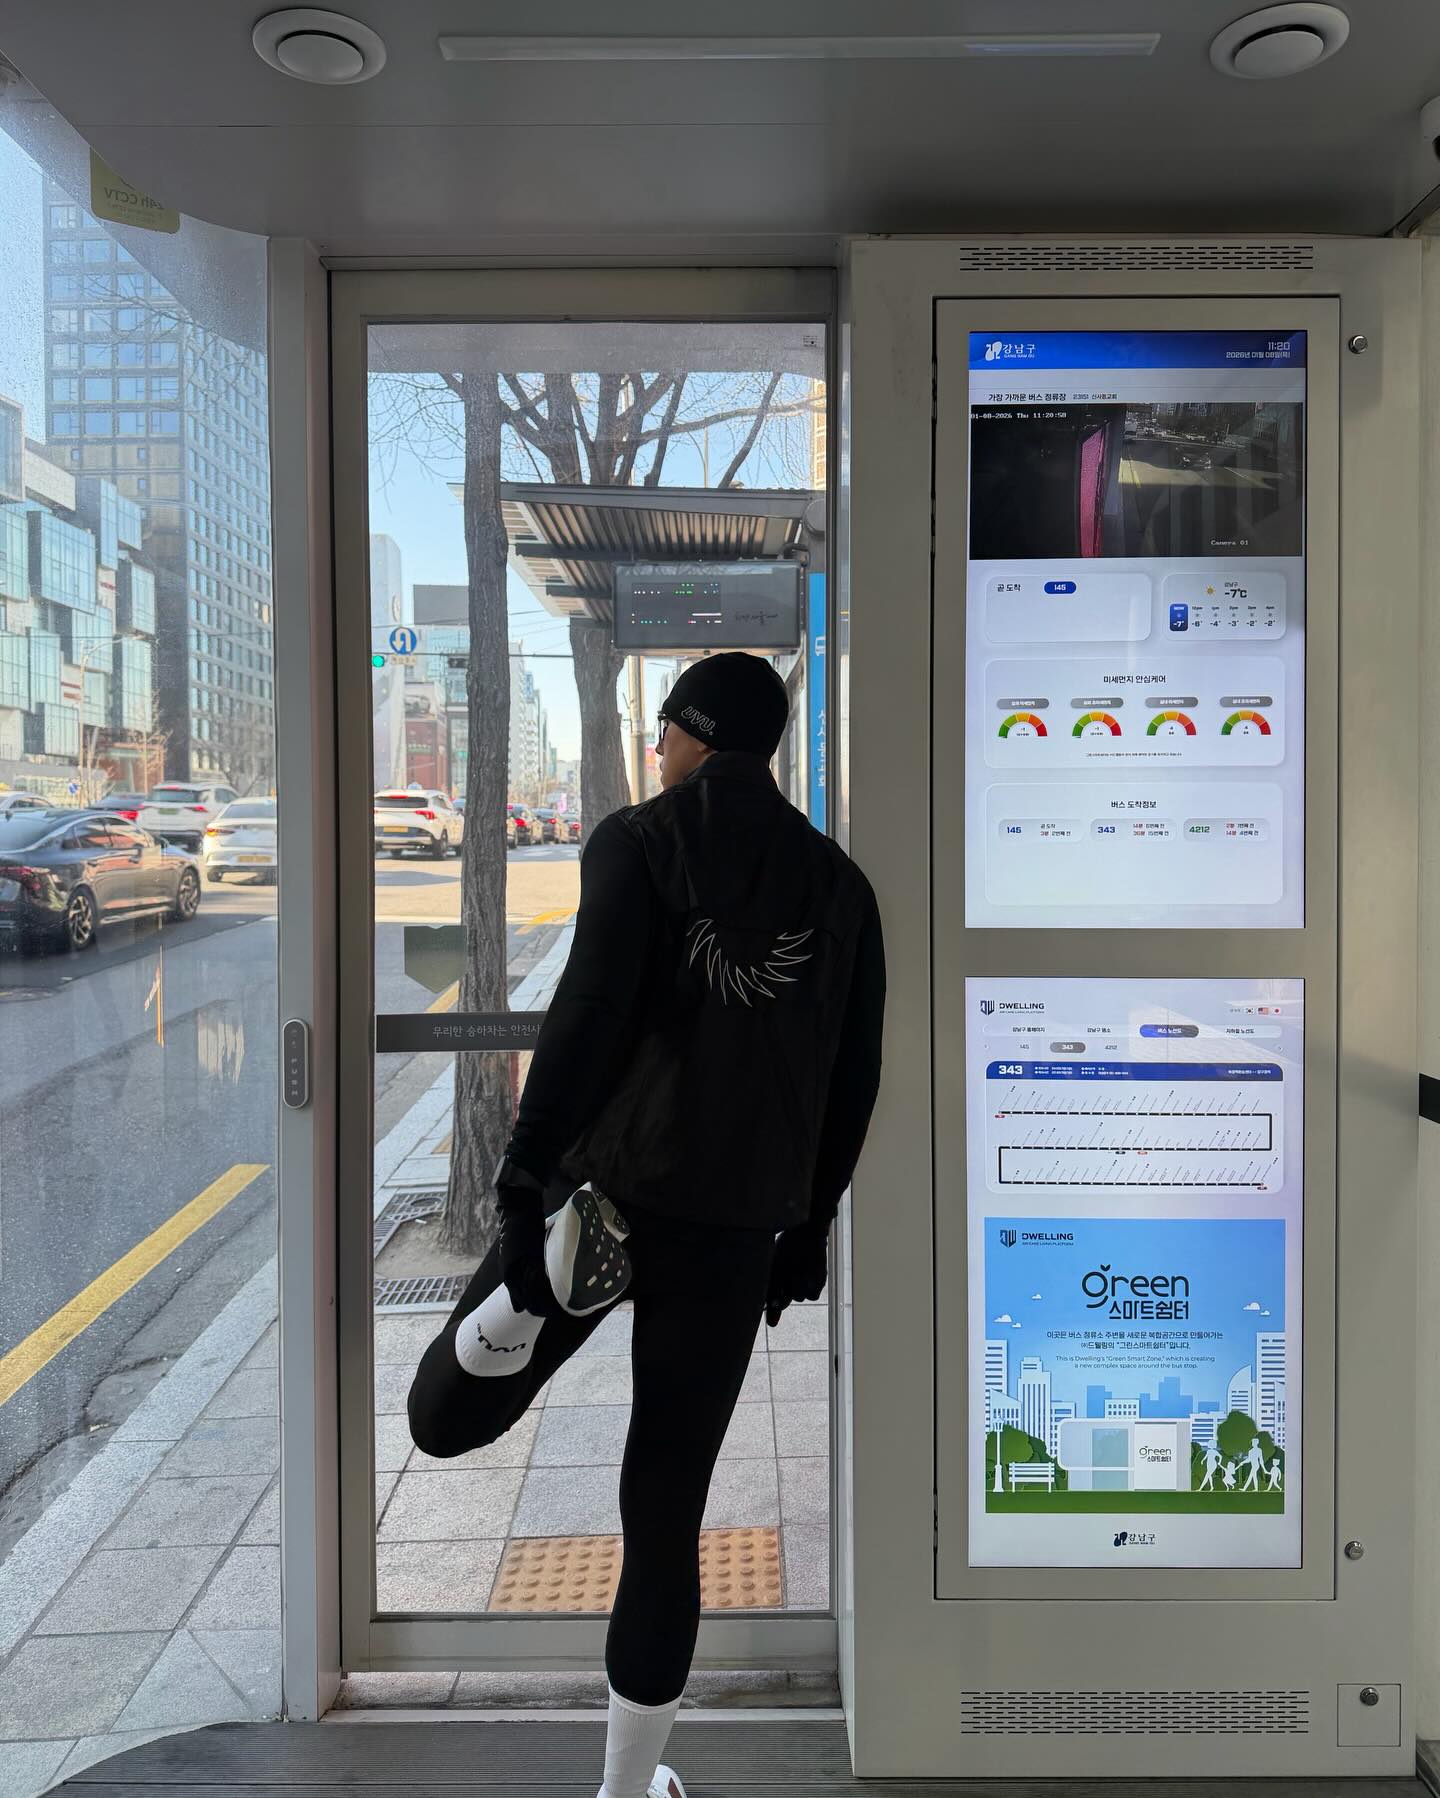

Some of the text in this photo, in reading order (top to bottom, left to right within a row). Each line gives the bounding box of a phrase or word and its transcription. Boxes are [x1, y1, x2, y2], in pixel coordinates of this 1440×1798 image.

[1003, 343, 1036, 354] 강남구
[1268, 341, 1290, 351] 11:20
[988, 393, 1003, 401] 가장
[1005, 393, 1026, 401] 가까운
[1028, 393, 1043, 401] 버스
[1045, 393, 1066, 401] 정류장
[997, 583, 1021, 592] 곧 도착
[1103, 675, 1166, 683] 미세먼지 안심케어
[999, 1002, 1044, 1010] DWELLING
[432, 1025, 462, 1038] 무리한
[466, 1025, 507, 1037] 승하차는
[999, 1065, 1023, 1075] 343
[1082, 1268, 1189, 1308] green
[1109, 1300, 1189, 1320] 스마트쉼터
[1047, 1331, 1224, 1339] 이곳은 버스 정류소 주변을 새로운 복합공간으로 만들어가는
[1139, 1447, 1171, 1459] green
[1128, 1533, 1156, 1541] 강남구
